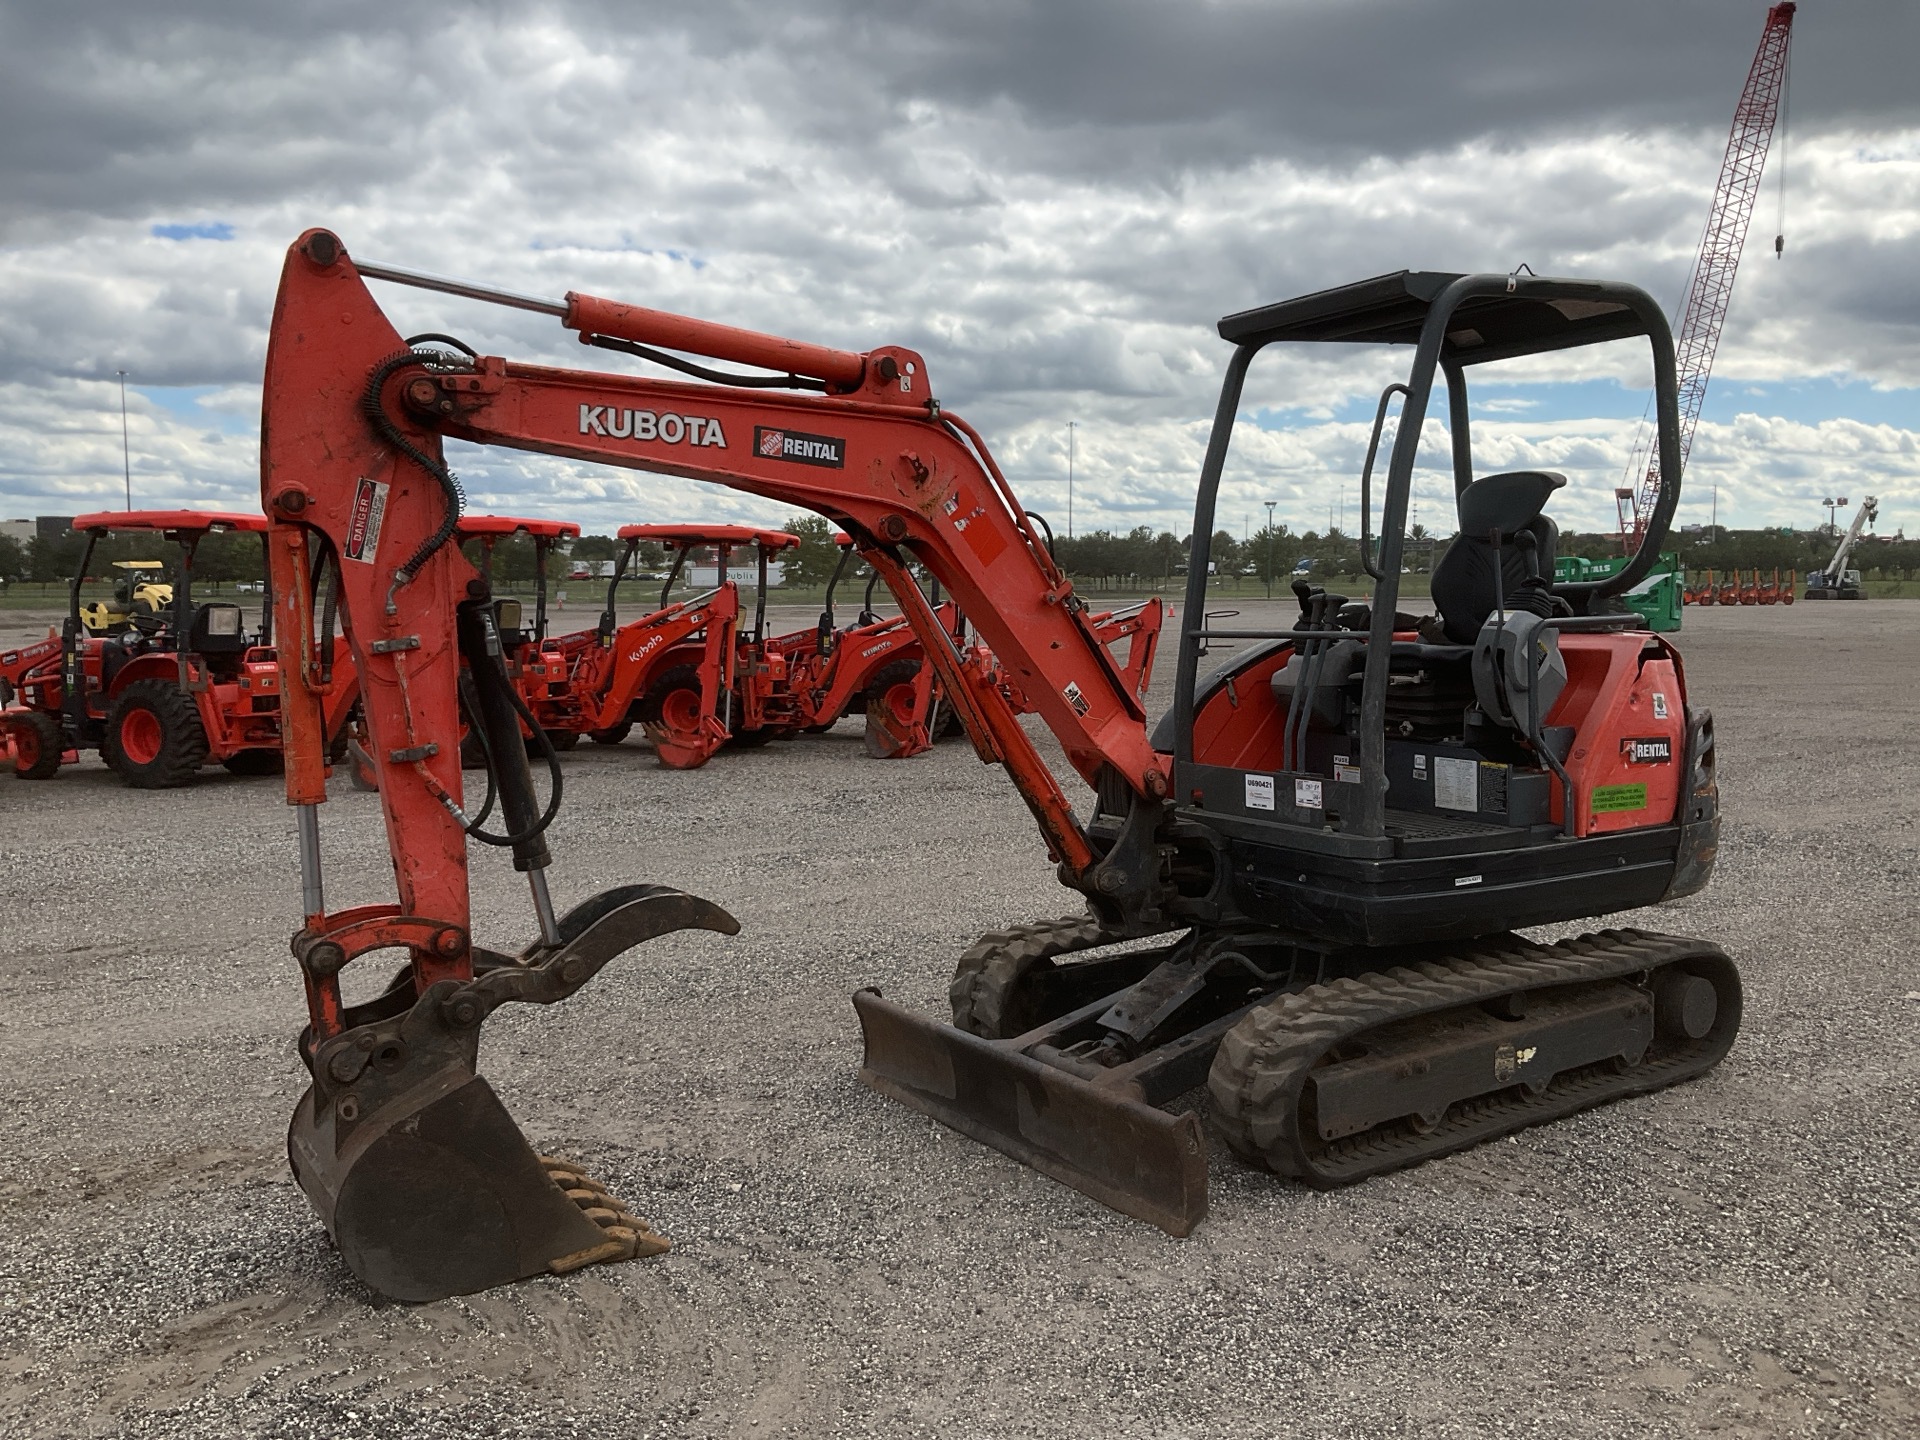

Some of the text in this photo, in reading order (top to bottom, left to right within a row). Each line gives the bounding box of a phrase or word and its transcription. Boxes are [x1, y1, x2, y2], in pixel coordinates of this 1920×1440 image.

[579, 404, 727, 448] KUBOTA
[761, 431, 784, 454] HOME
[784, 438, 839, 461] RENTAL
[353, 498, 369, 542] DANGER
[629, 634, 663, 662] Kubota
[862, 640, 893, 658] KUBOTA
[1636, 743, 1670, 758] RENTAL
[1247, 779, 1273, 789] U690421
